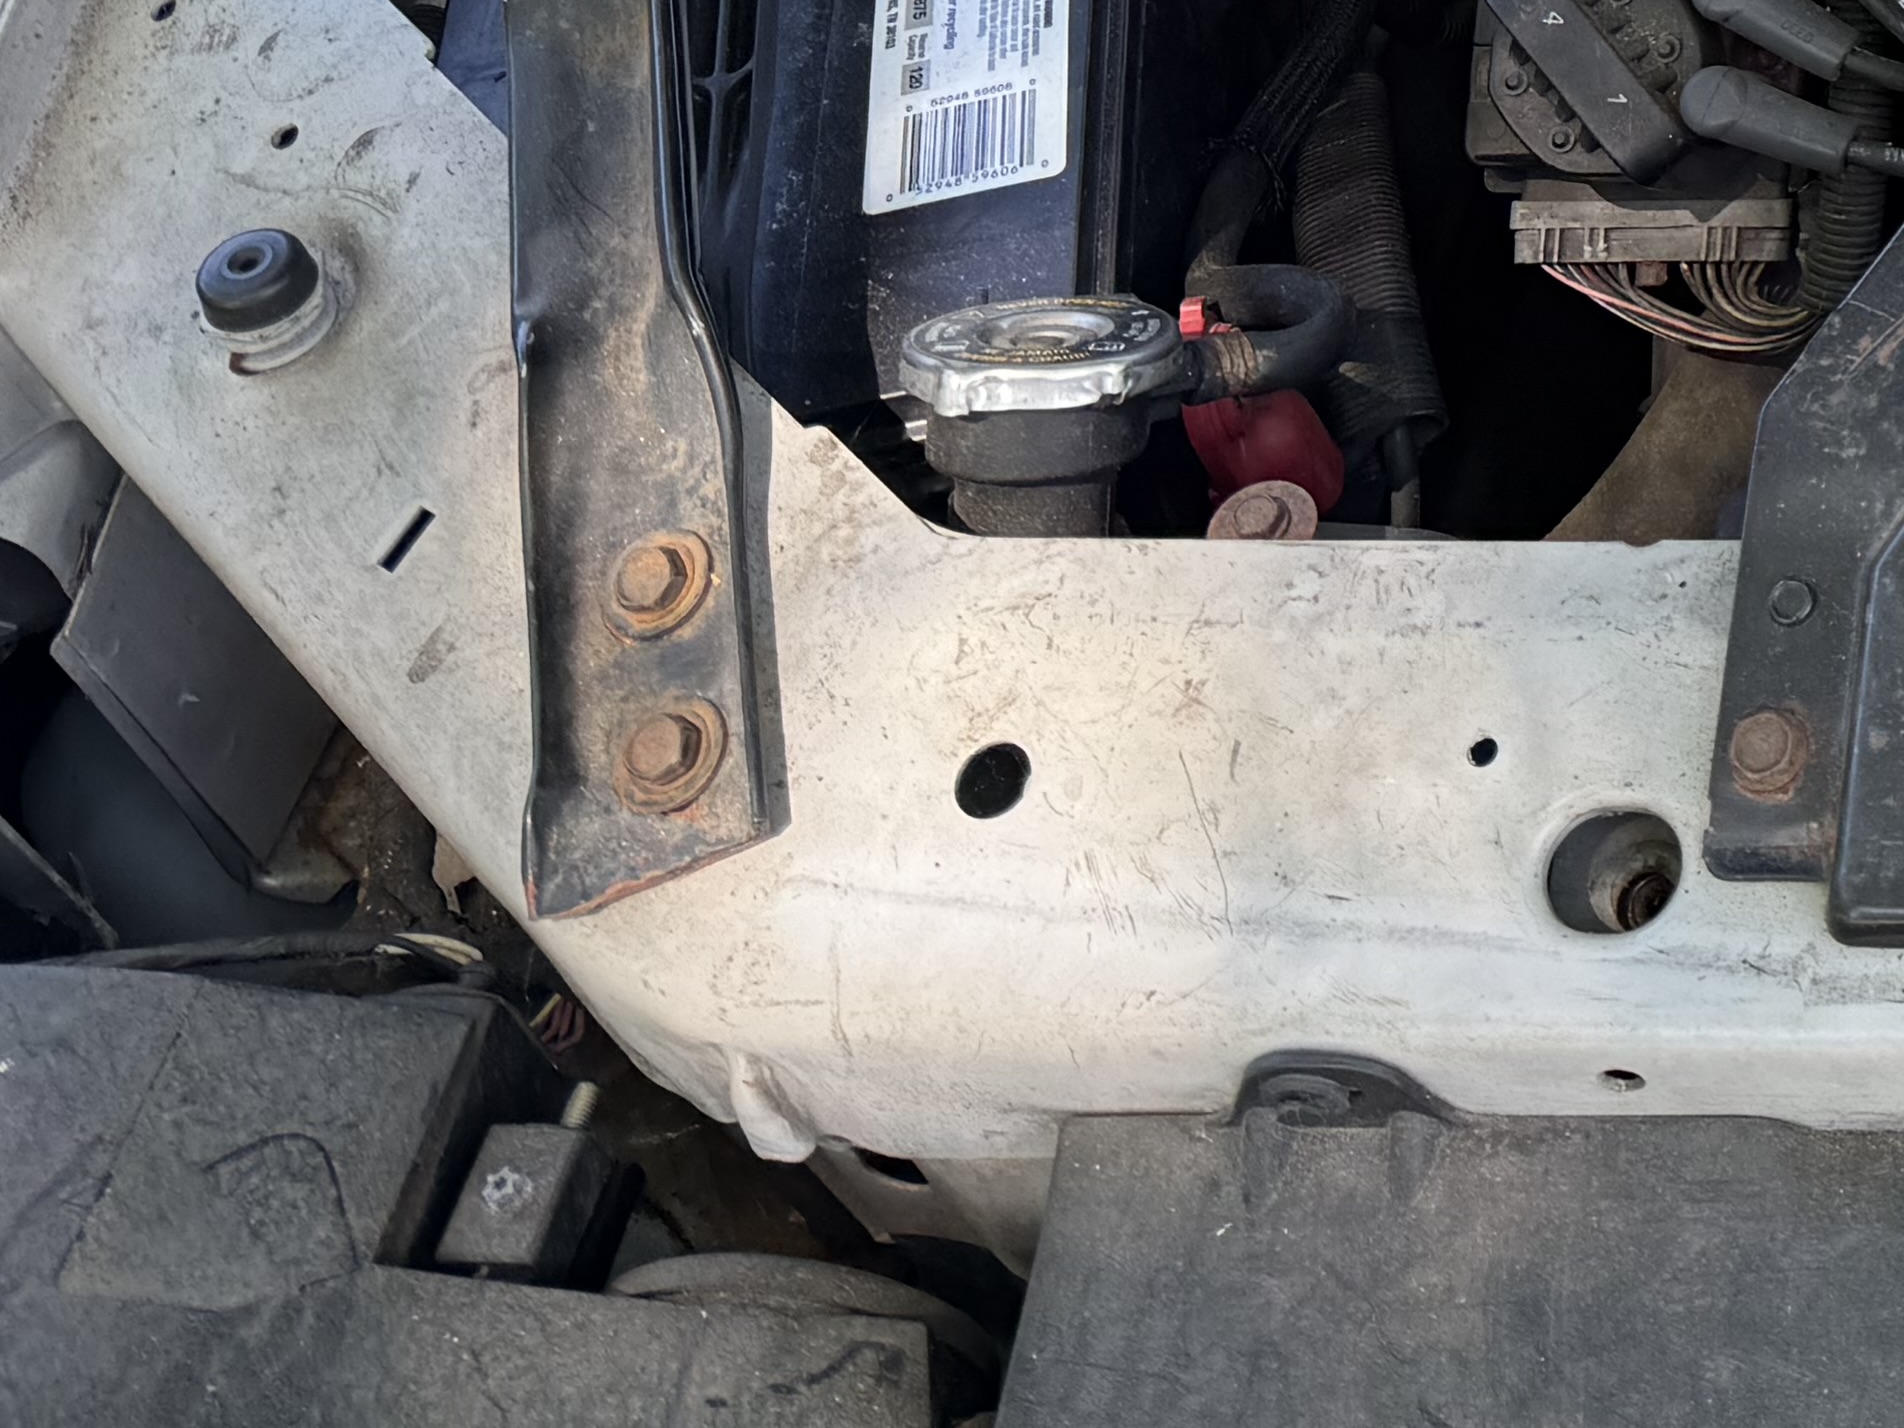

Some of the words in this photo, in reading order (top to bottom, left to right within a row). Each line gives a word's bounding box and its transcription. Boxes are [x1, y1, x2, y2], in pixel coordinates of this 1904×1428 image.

[1541, 11, 1565, 25] 4
[907, 64, 923, 91] 120
[1606, 93, 1628, 103] 1
